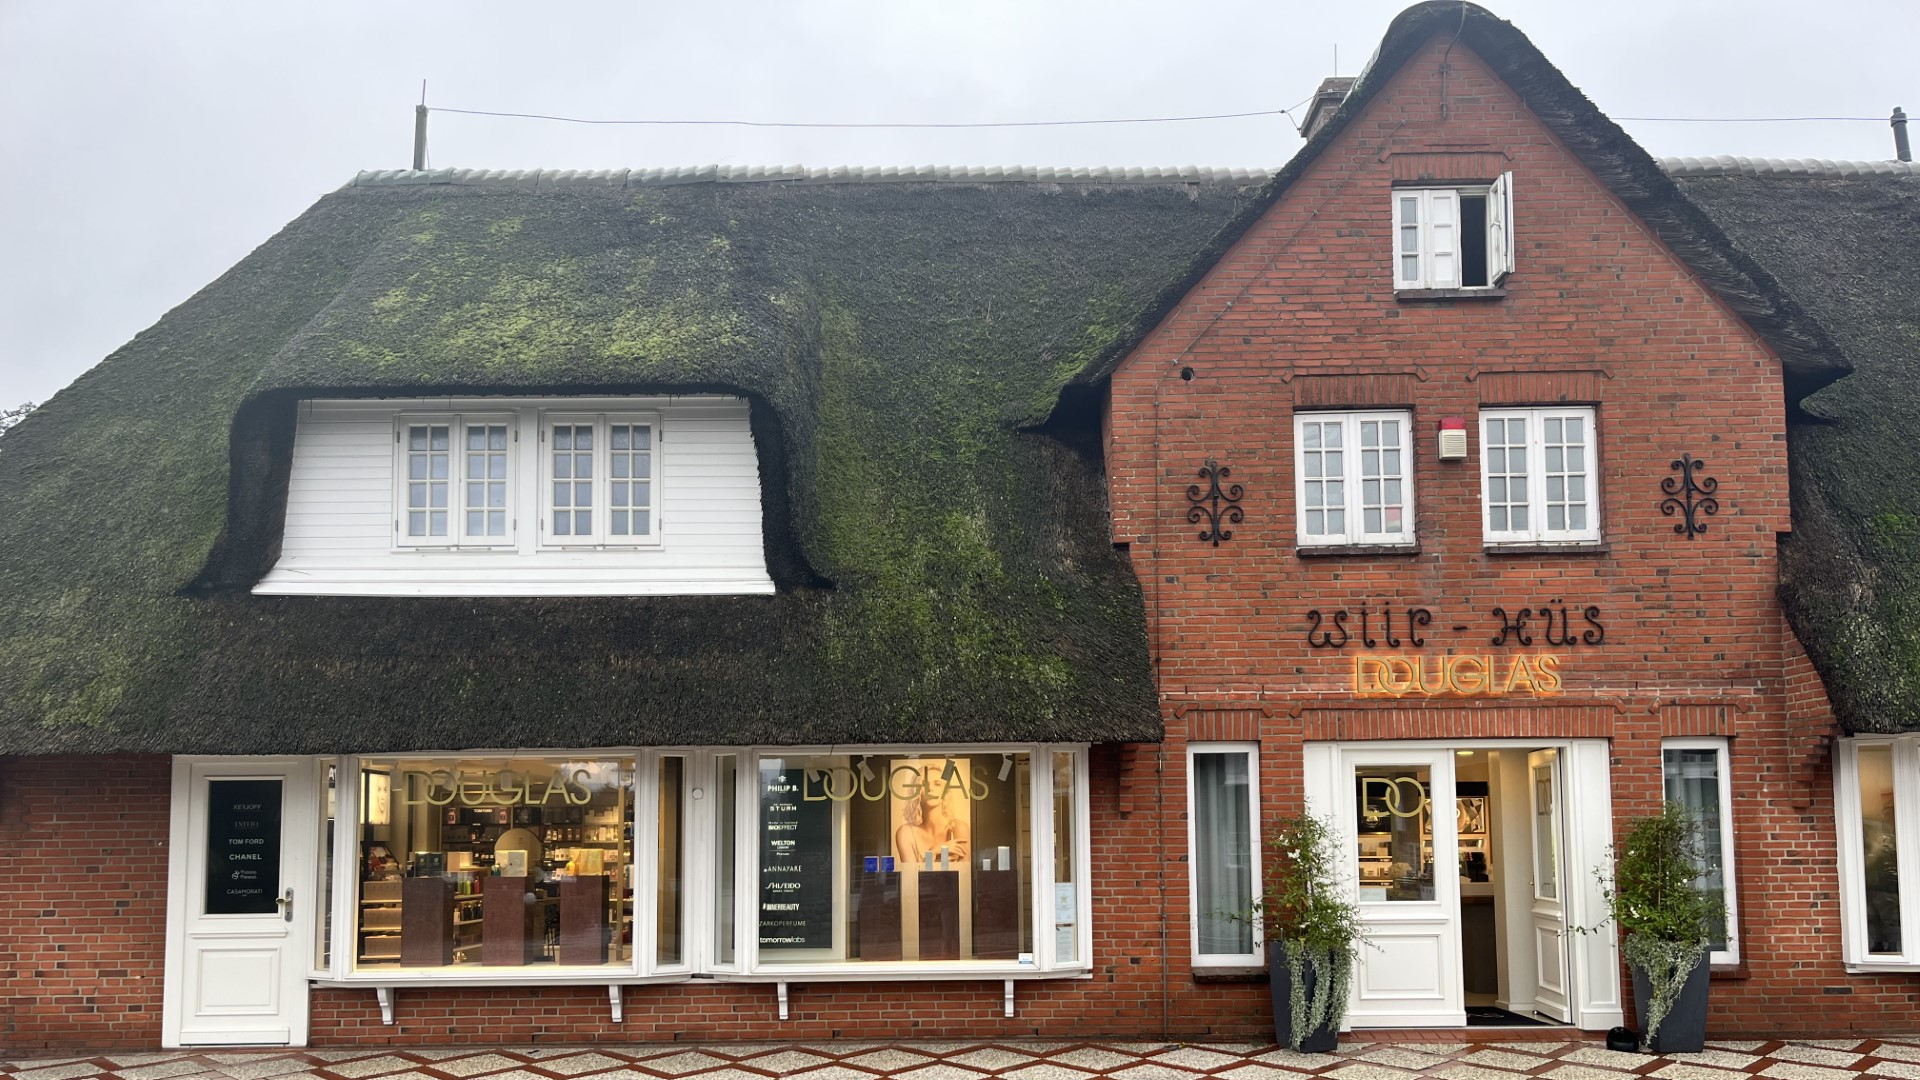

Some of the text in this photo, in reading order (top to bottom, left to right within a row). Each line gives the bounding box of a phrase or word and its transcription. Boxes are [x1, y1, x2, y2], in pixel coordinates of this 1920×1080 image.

[1356, 654, 1562, 694] DOUGLAS
[403, 769, 592, 806] DOUGLAS
[803, 765, 989, 802] DOUGLAS
[1362, 776, 1426, 818] DO
[765, 882, 801, 890] SHISEIDO
[760, 936, 806, 944] tomorrowlabs
